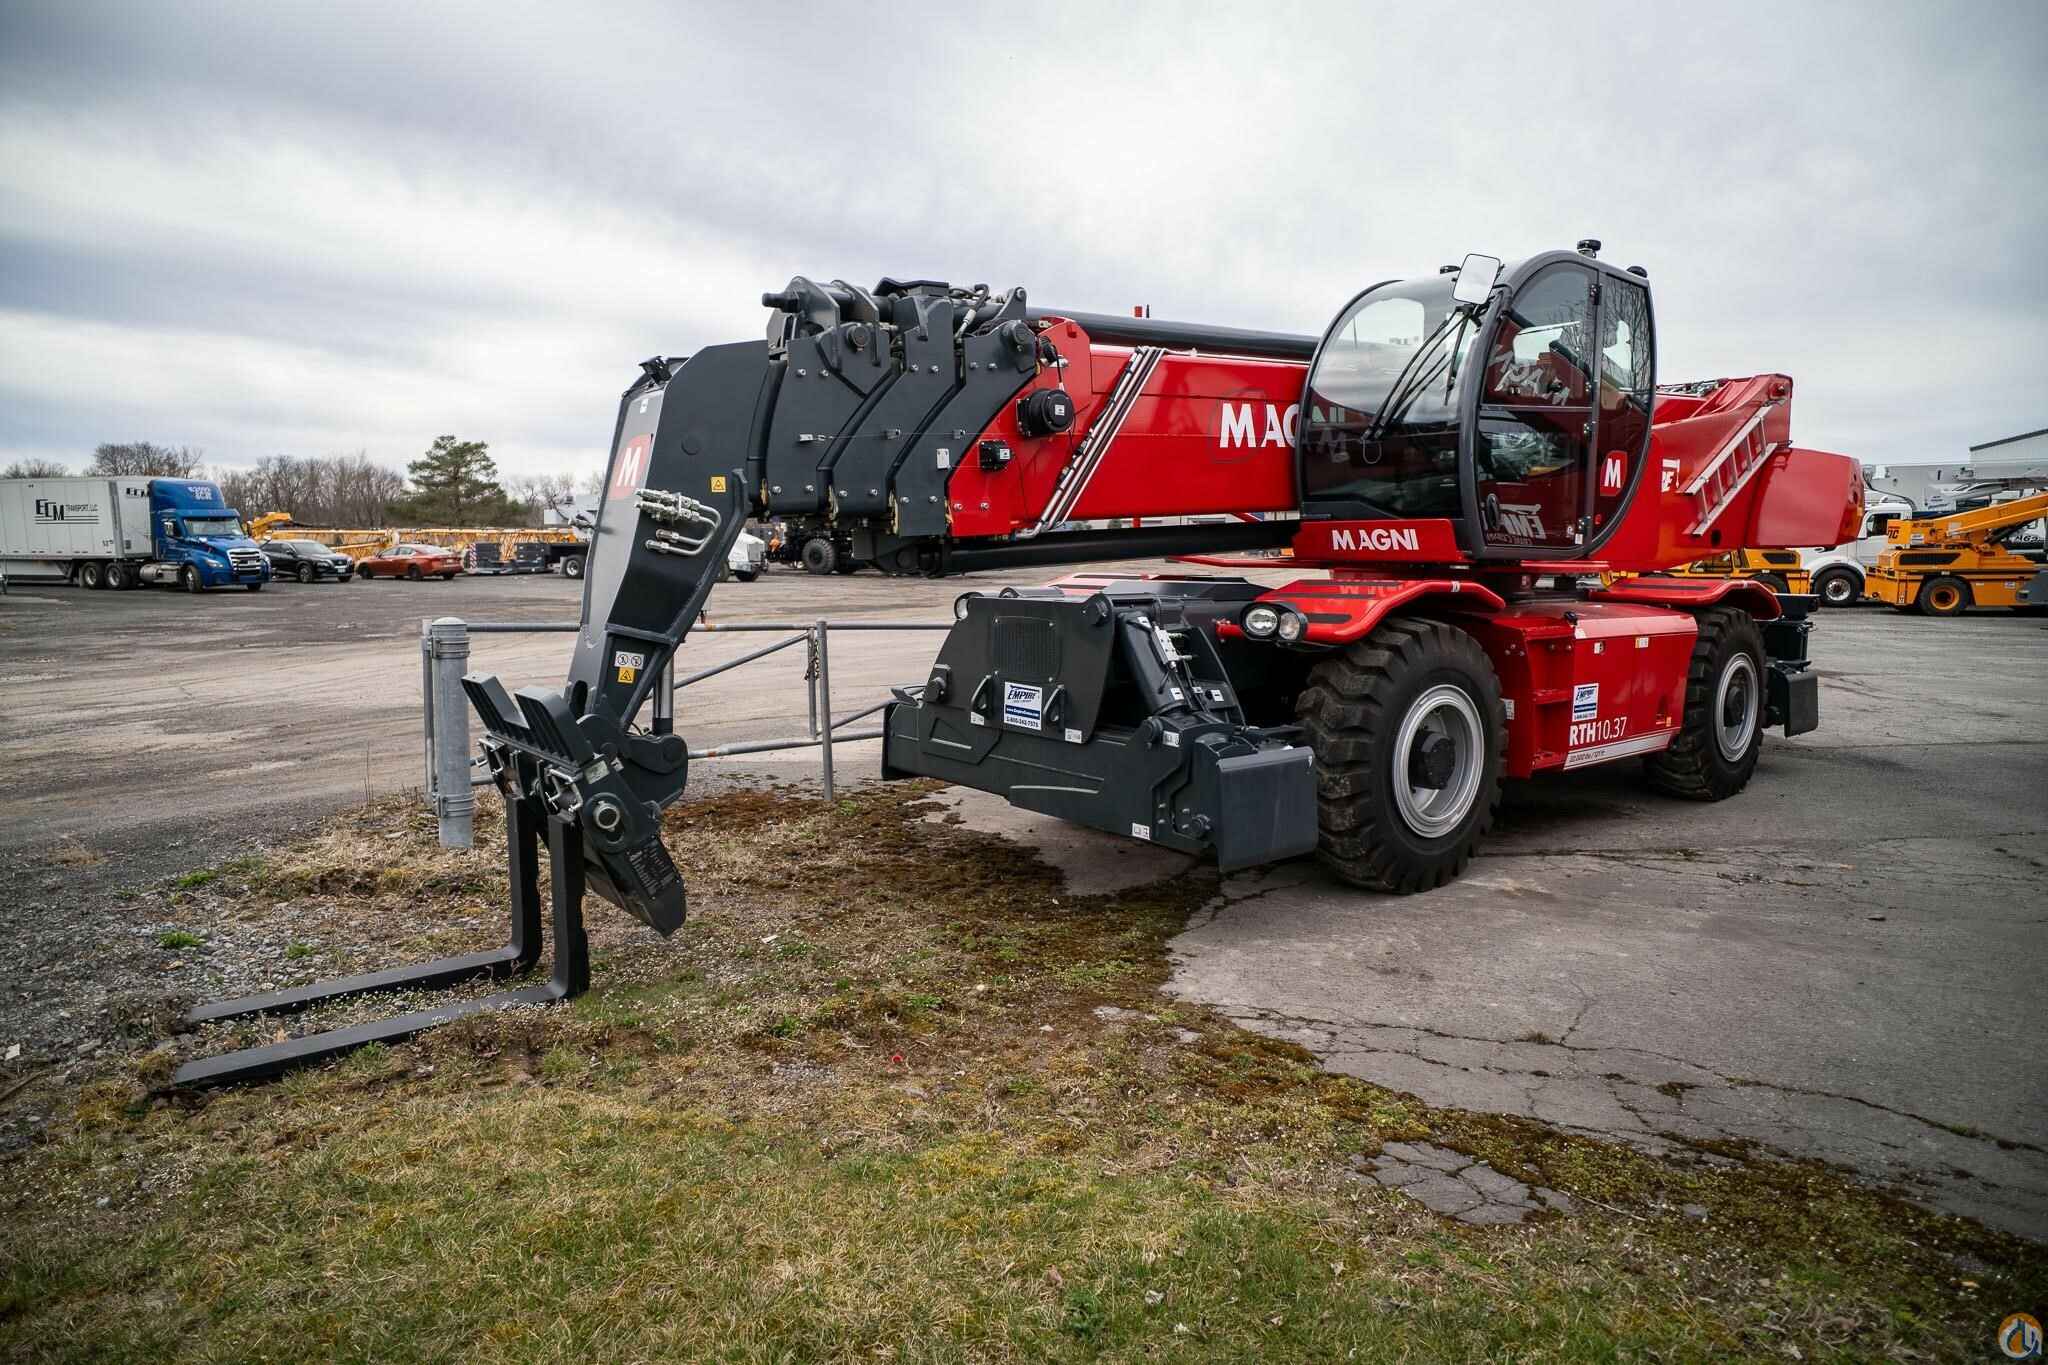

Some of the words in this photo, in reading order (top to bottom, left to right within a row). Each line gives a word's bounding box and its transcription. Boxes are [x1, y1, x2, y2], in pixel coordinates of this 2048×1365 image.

[616, 446, 642, 487] M
[1604, 458, 1621, 489] M
[35, 499, 65, 520] ECM
[1332, 528, 1420, 551] MAGNI
[1007, 689, 1037, 700] EMPIRE
